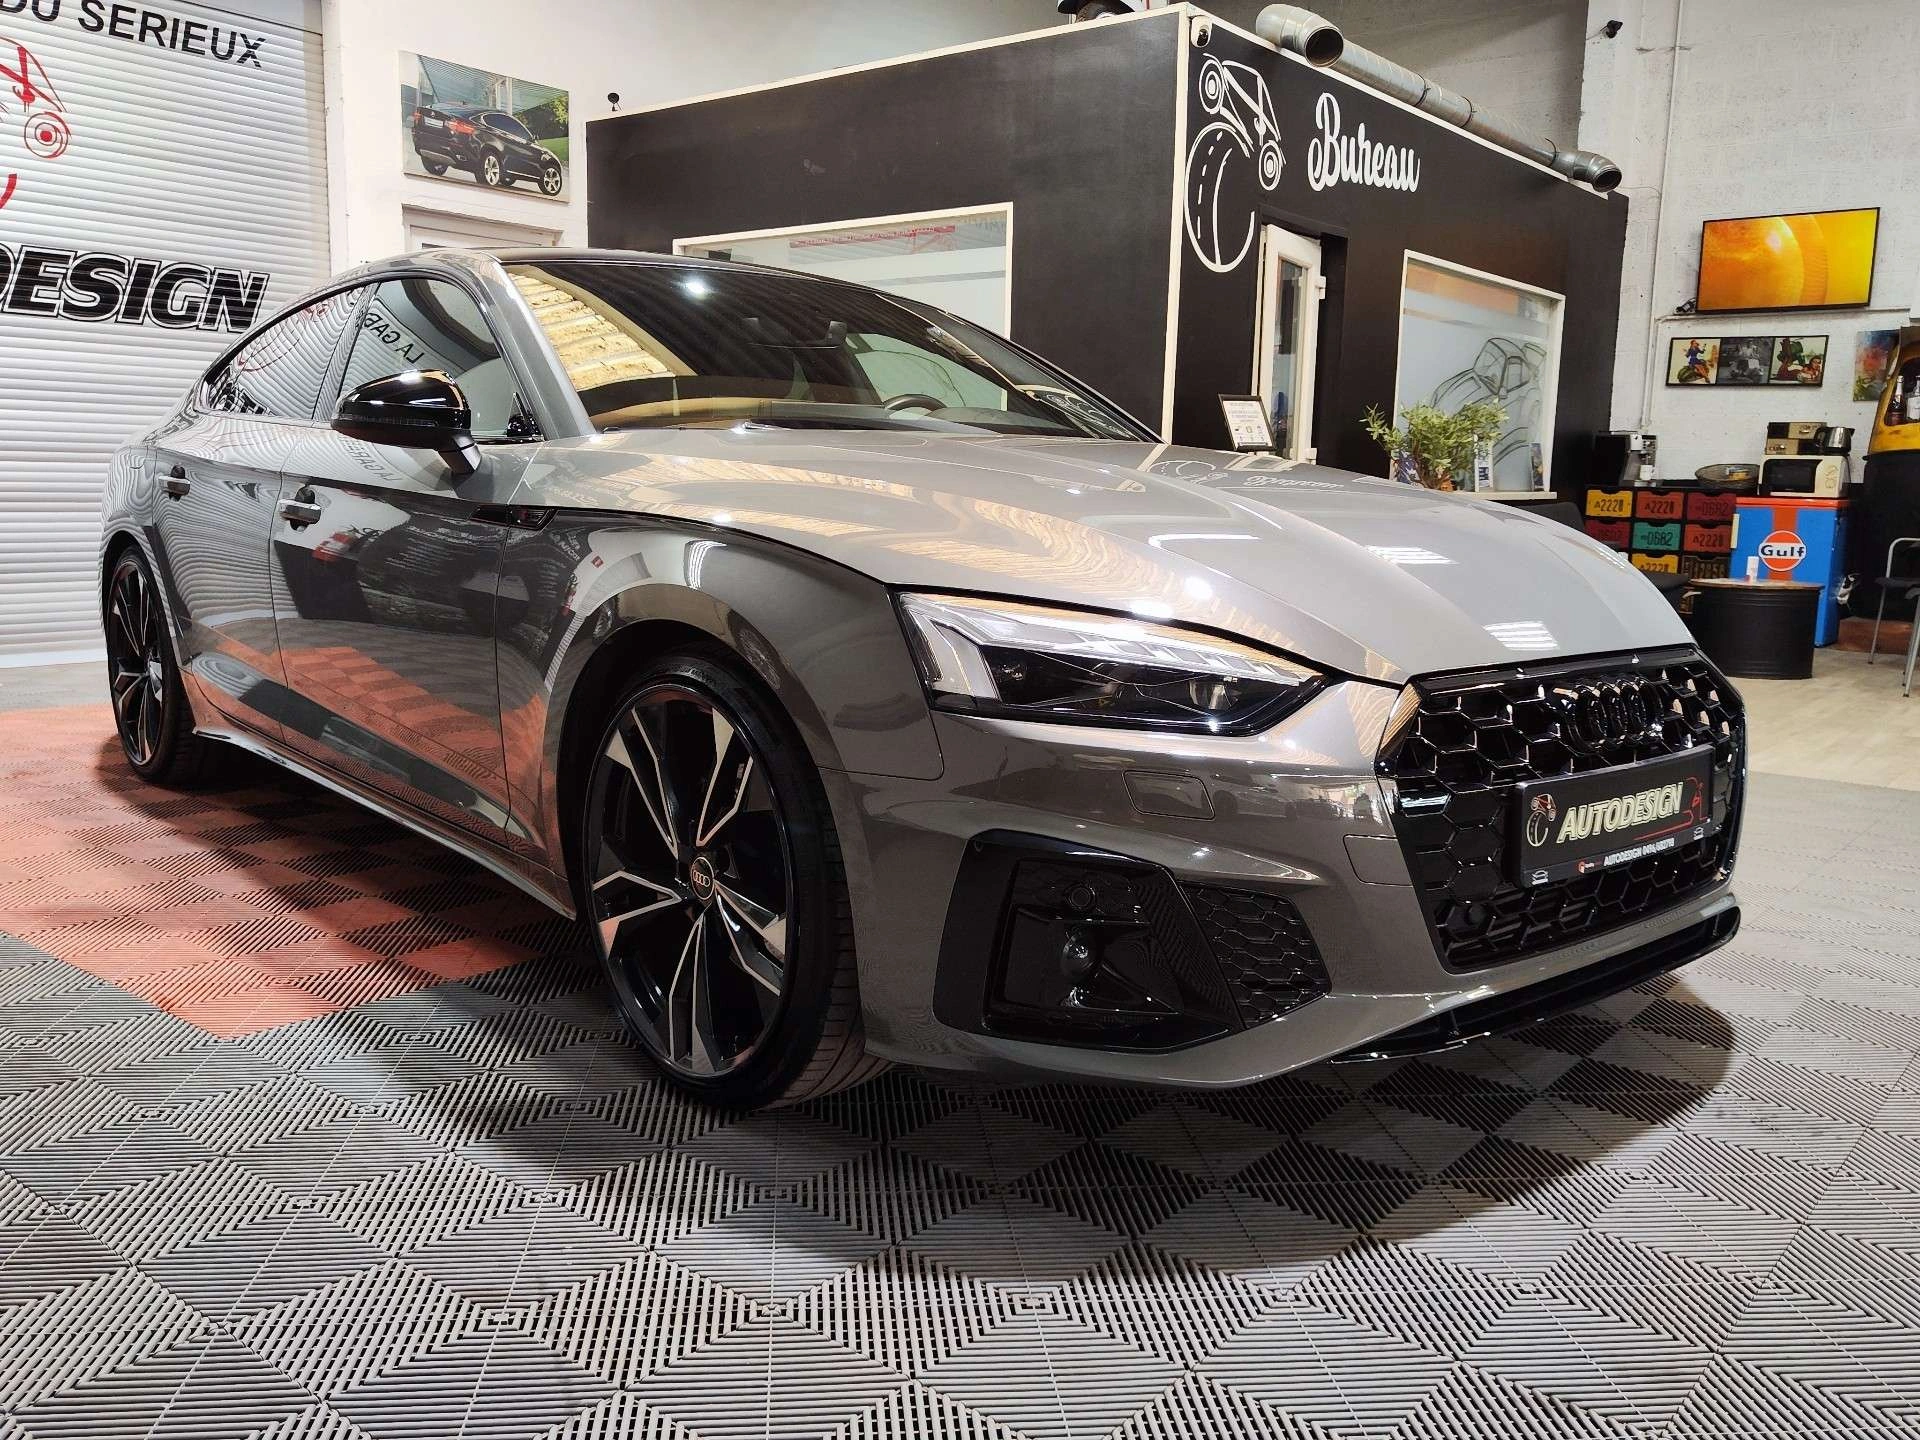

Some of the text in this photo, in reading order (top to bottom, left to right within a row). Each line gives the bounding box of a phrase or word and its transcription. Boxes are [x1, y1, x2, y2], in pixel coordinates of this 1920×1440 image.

[78, 0, 266, 68] SERIEUX
[1307, 92, 1421, 192] Bureau
[0, 242, 270, 334] ESIGN
[1760, 544, 1805, 557] Gulf
[1556, 782, 1684, 843] AUTODESIGN
